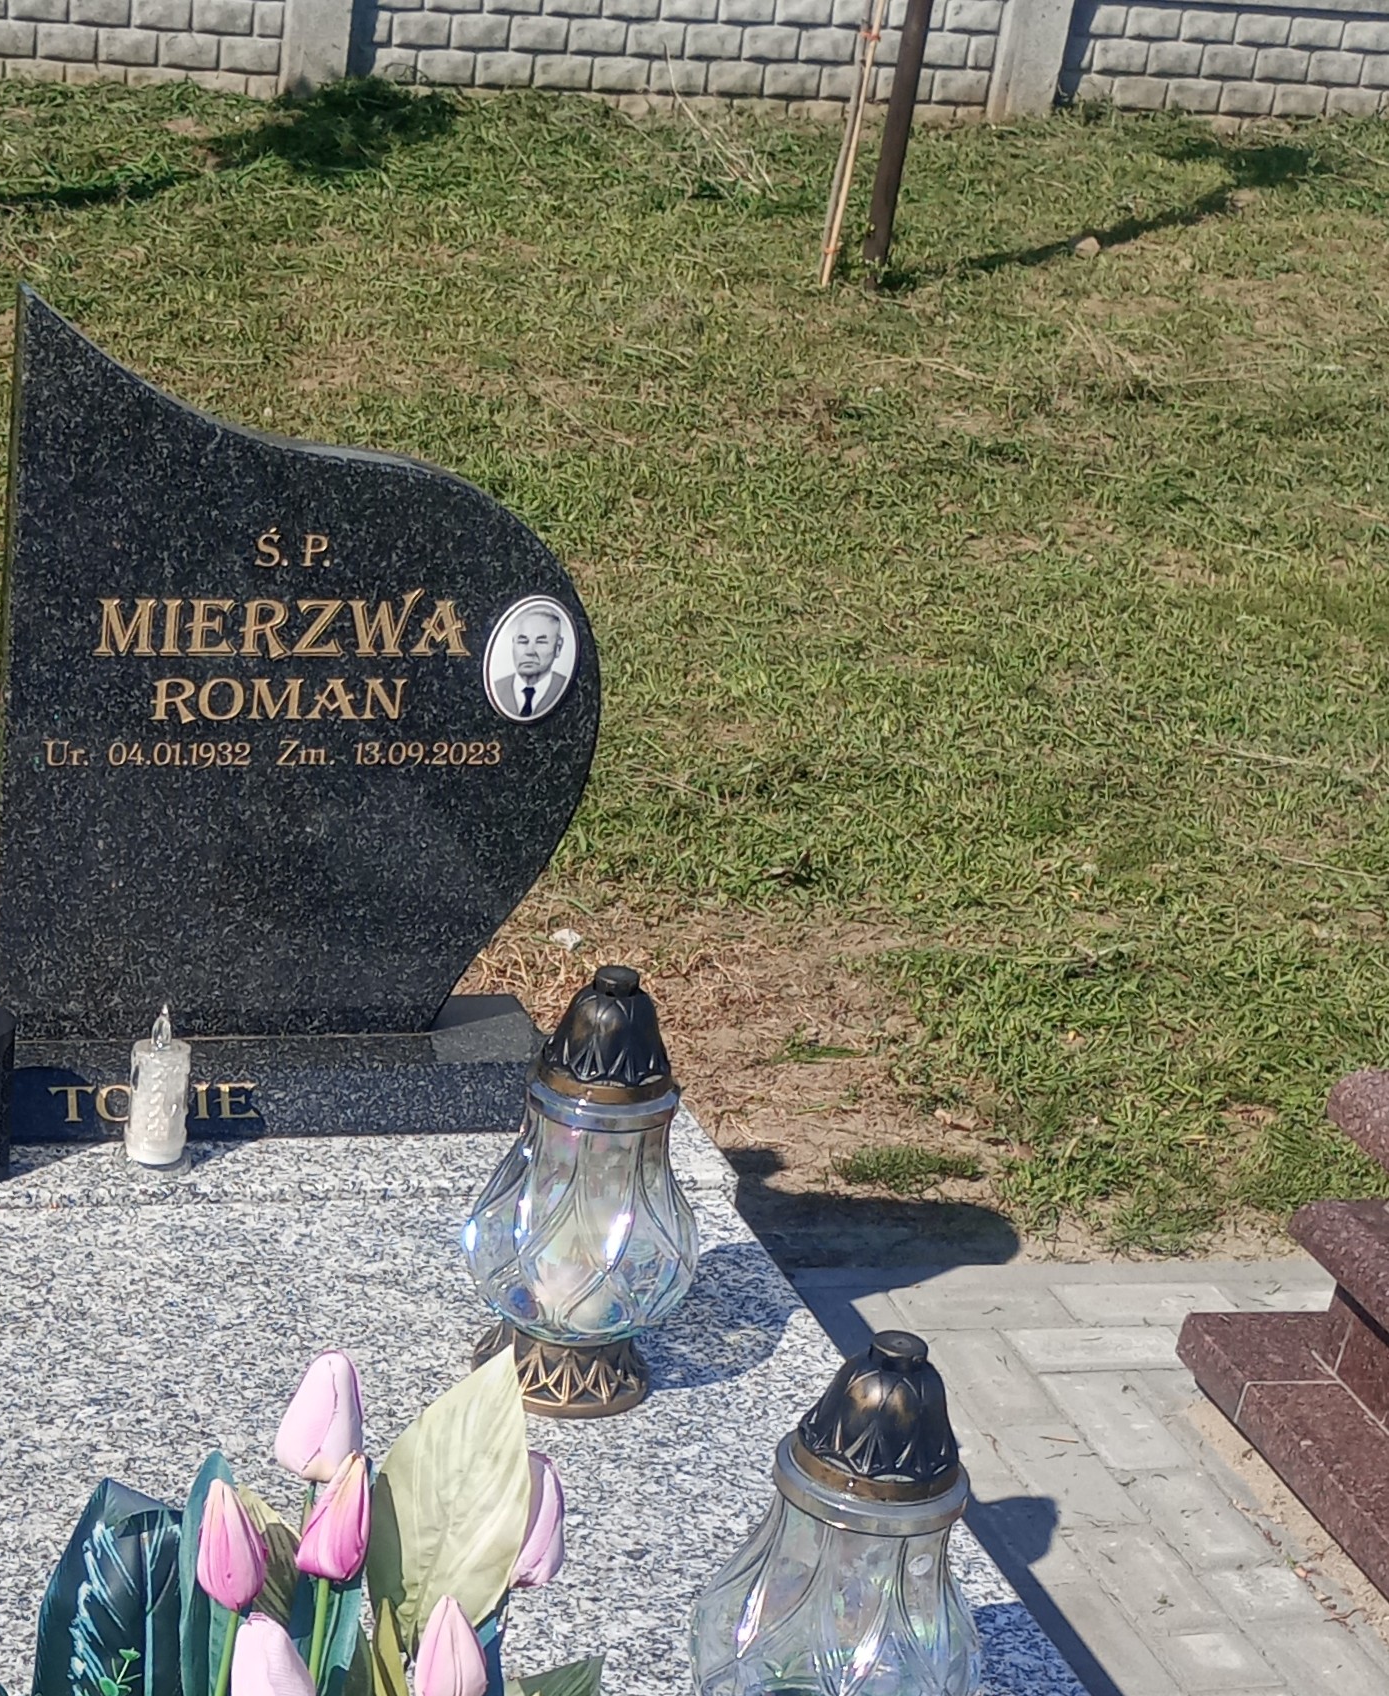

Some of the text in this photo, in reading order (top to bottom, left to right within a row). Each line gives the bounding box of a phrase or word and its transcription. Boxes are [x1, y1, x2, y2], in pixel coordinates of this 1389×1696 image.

[254, 527, 331, 568] Ś. P.
[93, 588, 470, 659] MIERZWA
[150, 677, 408, 724] ROMAN
[43, 739, 502, 769] Ur. 04.01.1932 Zm. 13.09.2023
[48, 1081, 259, 1123] TOIE
